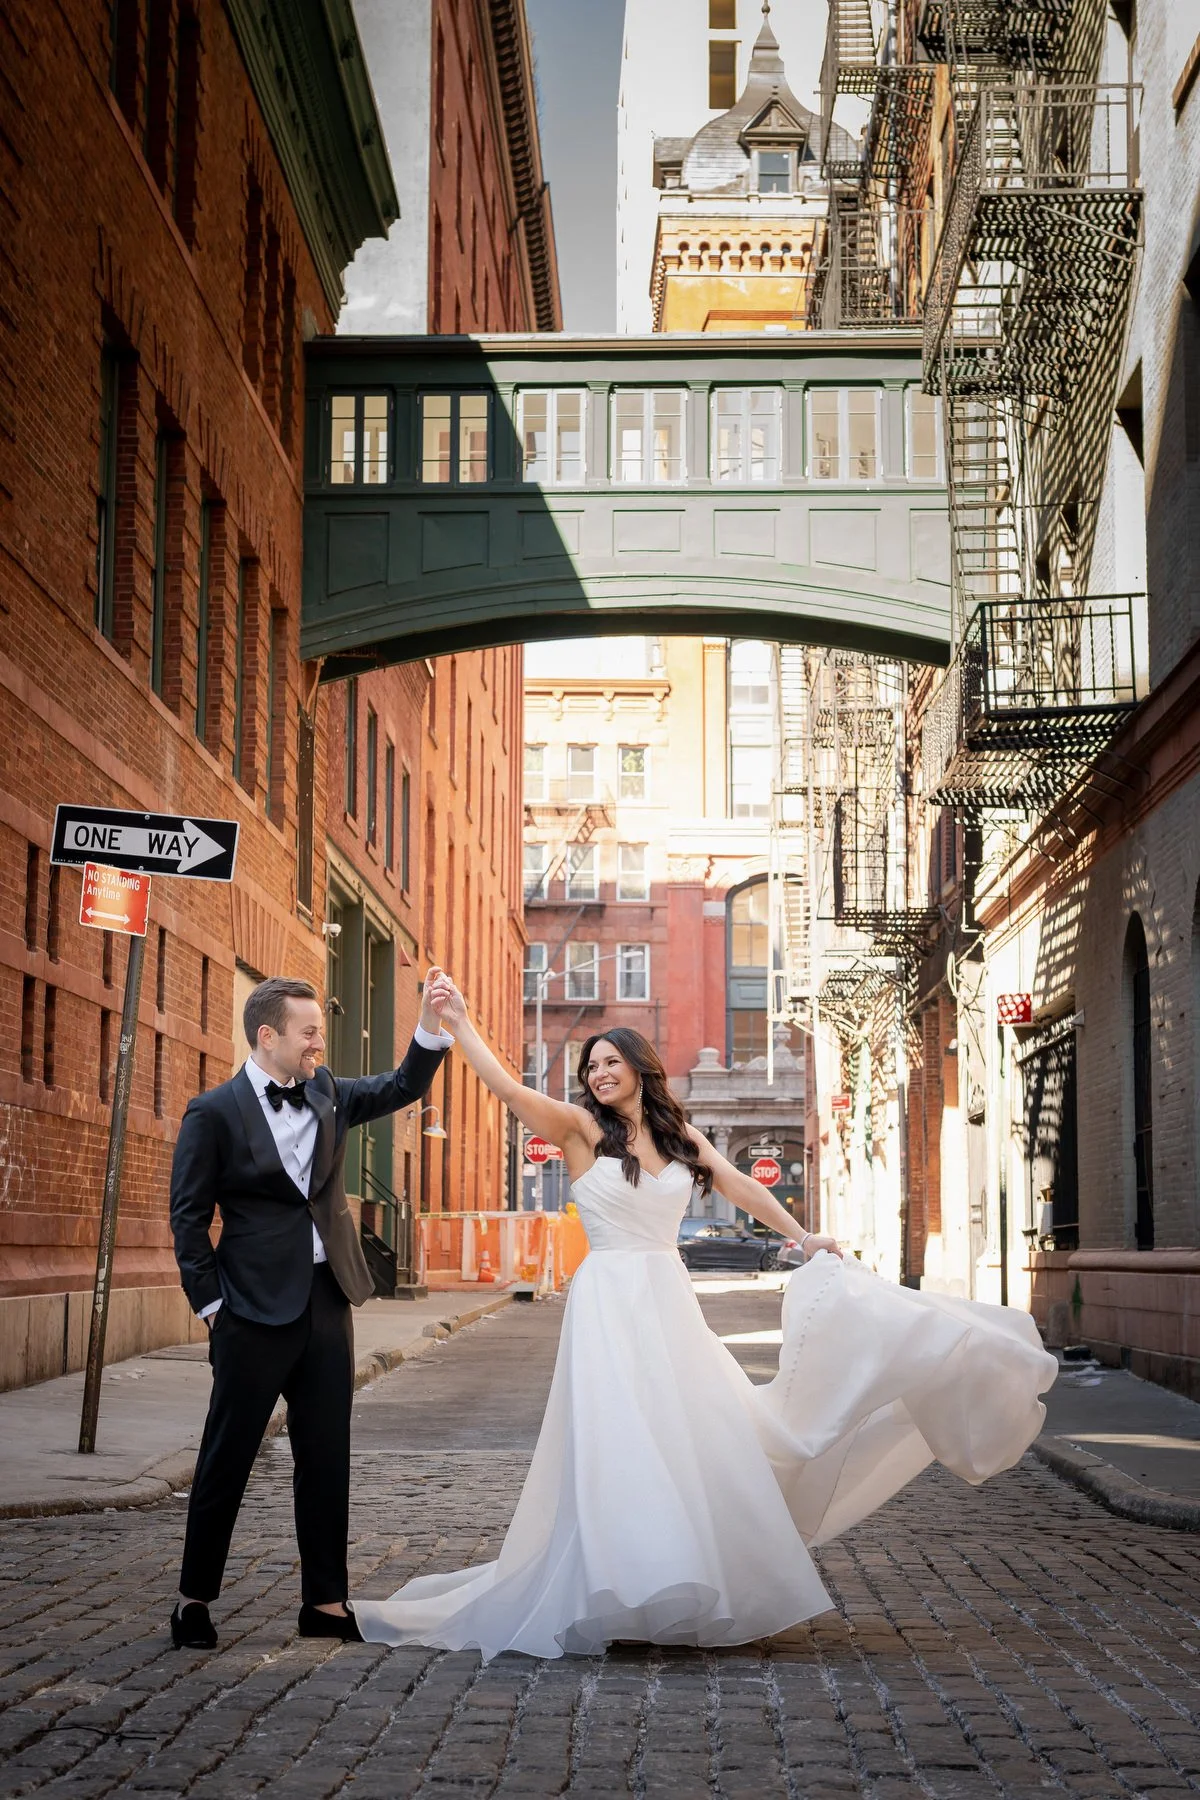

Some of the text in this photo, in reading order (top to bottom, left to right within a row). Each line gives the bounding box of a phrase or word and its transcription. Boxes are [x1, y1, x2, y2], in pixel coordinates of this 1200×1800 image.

[74, 825, 200, 858] ONE WAY
[87, 869, 140, 891] NO STANDING
[86, 883, 120, 900] Anytime
[526, 1143, 549, 1156] STOP
[754, 1166, 778, 1179] STOP
